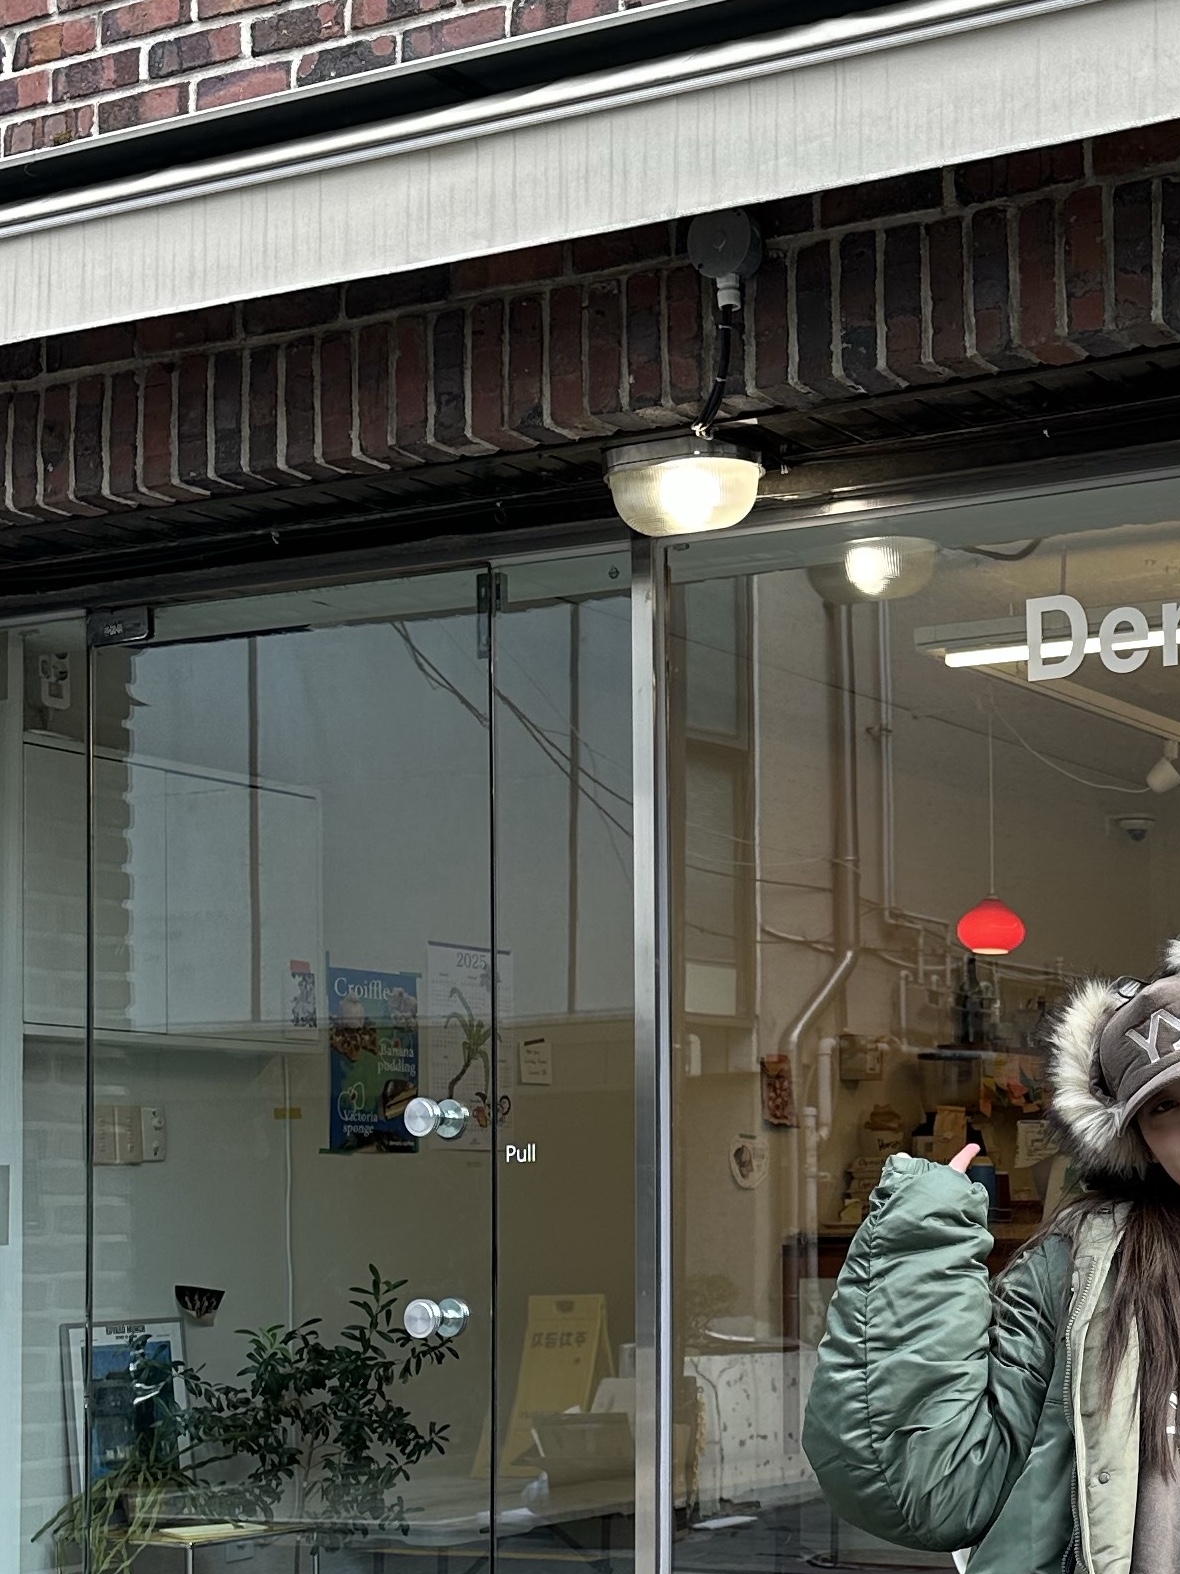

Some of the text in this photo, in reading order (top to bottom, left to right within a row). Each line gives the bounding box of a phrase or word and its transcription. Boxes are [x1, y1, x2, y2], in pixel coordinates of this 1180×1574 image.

[456, 952, 488, 970] 2025
[333, 976, 391, 1000] Croiffle
[380, 1043, 414, 1058] Banana
[343, 1109, 378, 1123] Victoria
[342, 1124, 375, 1138] sponge
[505, 1143, 537, 1163] Pull
